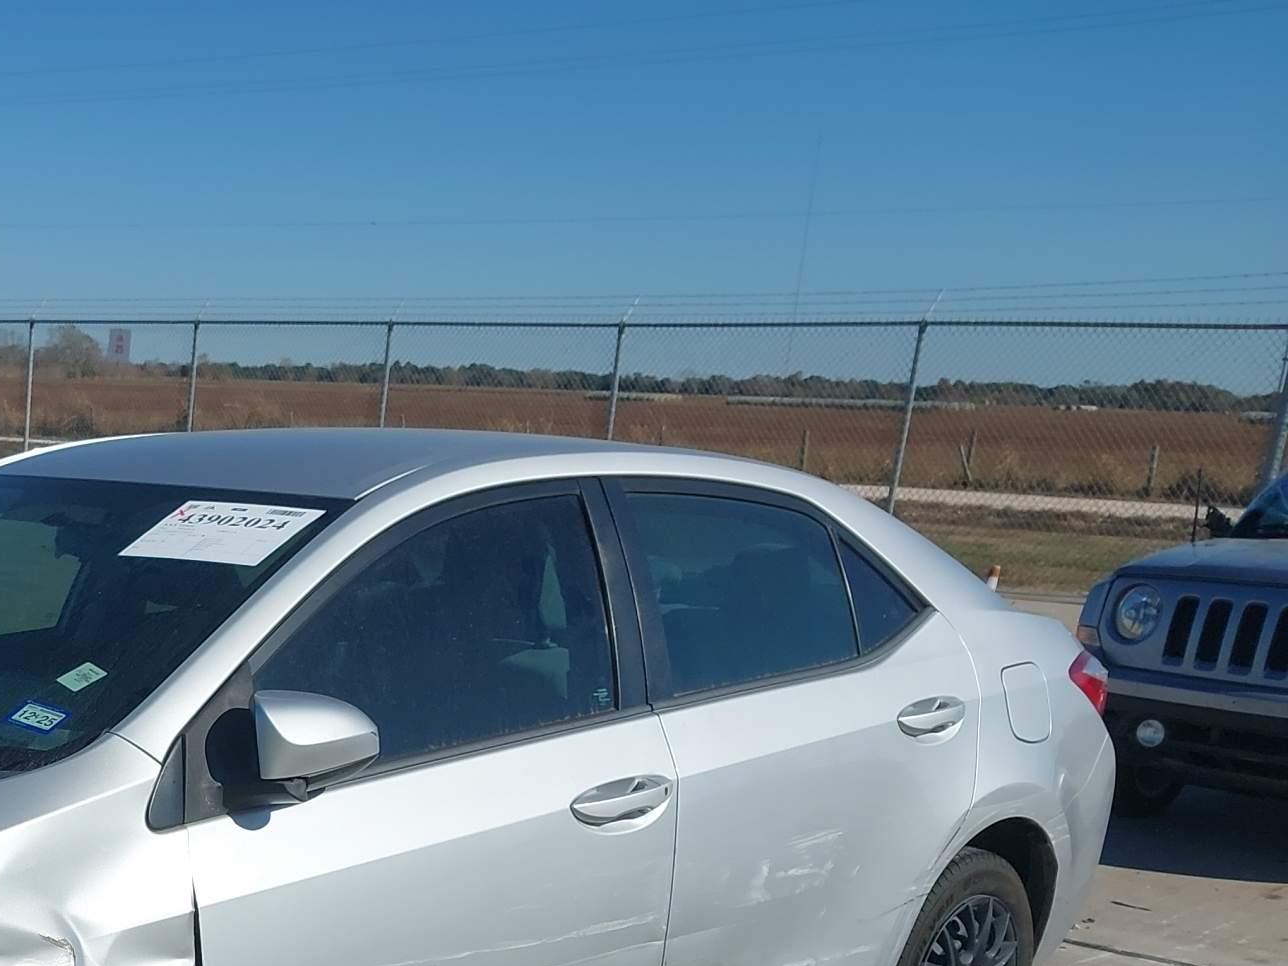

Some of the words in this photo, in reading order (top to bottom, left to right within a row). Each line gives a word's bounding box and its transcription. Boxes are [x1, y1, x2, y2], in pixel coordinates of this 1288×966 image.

[178, 513, 290, 530] 43902024
[18, 709, 38, 721] 12
[35, 715, 58, 727] 25
